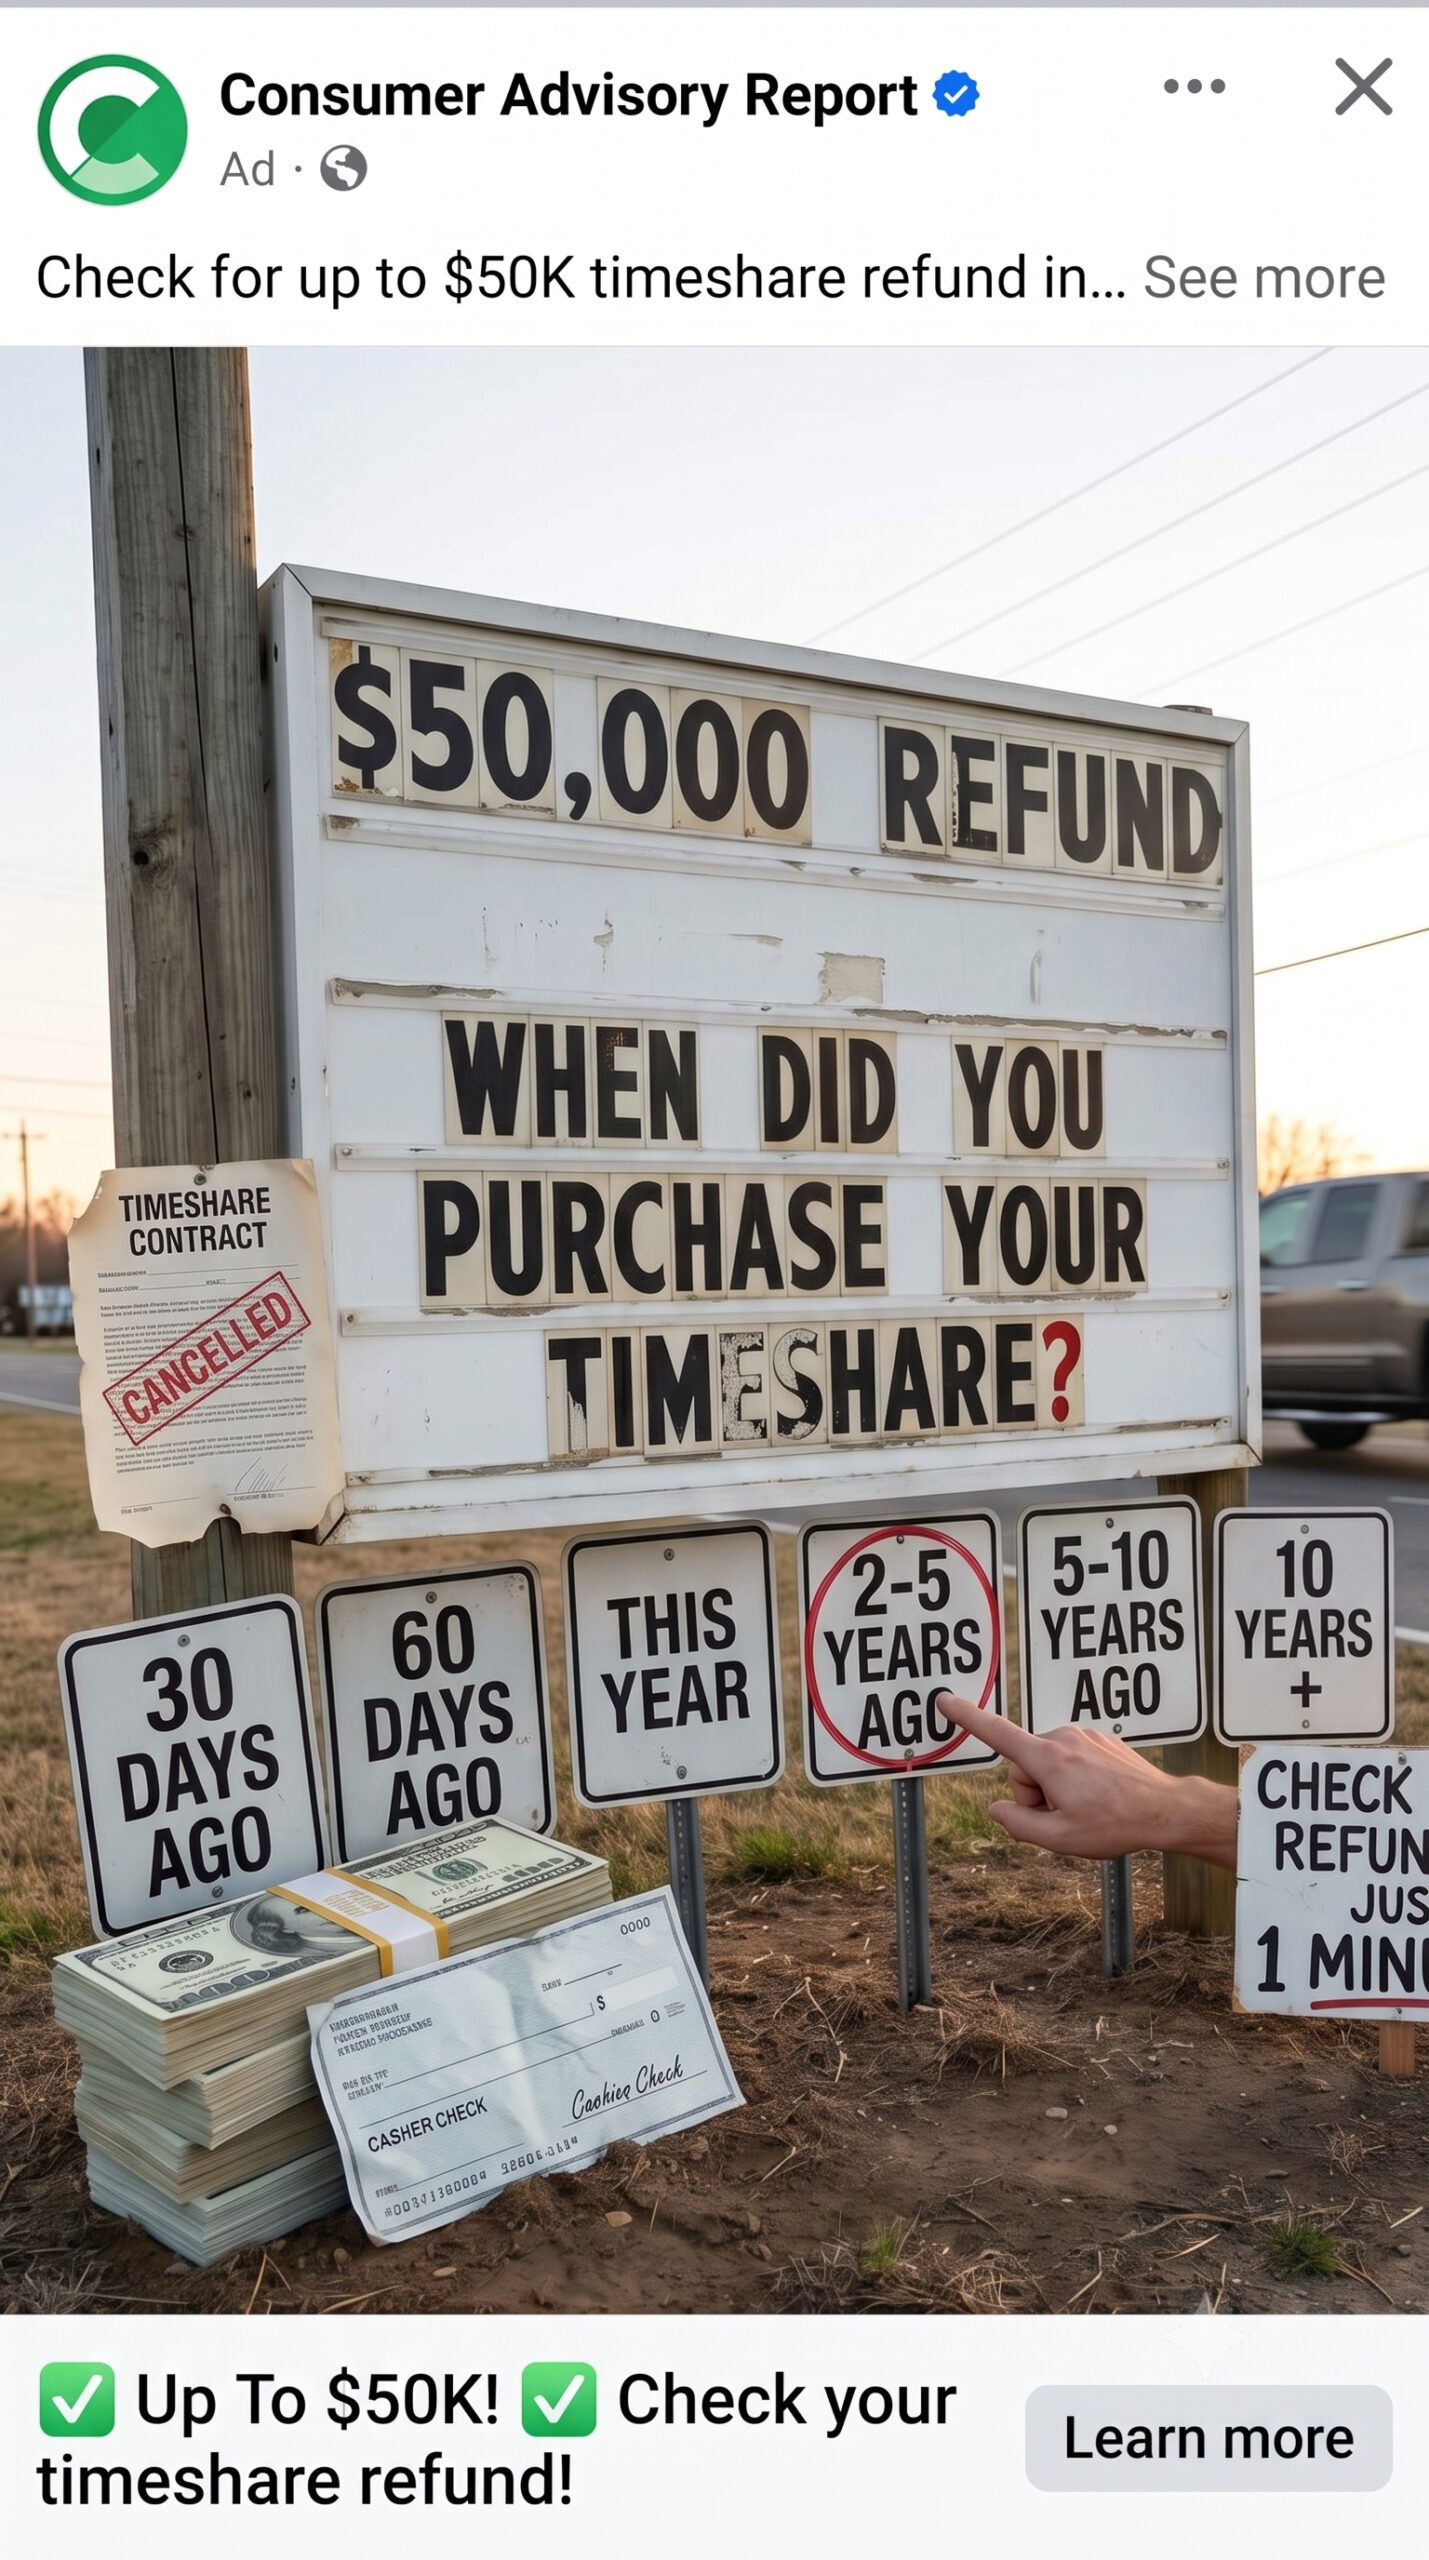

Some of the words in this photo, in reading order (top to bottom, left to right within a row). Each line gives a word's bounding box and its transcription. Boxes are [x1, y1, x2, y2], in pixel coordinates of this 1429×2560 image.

[334, 646, 809, 830] $50,000
[885, 726, 1223, 873] REFUND
[445, 1020, 698, 1140] WHEN
[762, 1035, 896, 1143] DID
[954, 1045, 1104, 1150] YOU
[119, 1187, 271, 1222] TIMESHARE
[129, 1222, 267, 1256] CONTRACT
[423, 1180, 886, 1296] PURCHASE
[945, 1186, 1145, 1285] YOUR
[122, 1292, 292, 1425] CANCELLED
[548, 1321, 1081, 1451] TIMESHARE?
[852, 1548, 950, 1617] 2-5
[1053, 1529, 1169, 1596] 5-10
[1276, 1539, 1333, 1598] 10
[392, 1605, 475, 1680] 60
[607, 1588, 736, 1659] THIS
[824, 1618, 982, 1686] YEARS
[1040, 1598, 1185, 1660] YEARS
[1235, 1608, 1373, 1658] YEARS
[142, 1647, 233, 1732] 30
[363, 1681, 513, 1762] DAYS
[601, 1660, 750, 1733] YEAR
[858, 1687, 957, 1750] AGO
[1070, 1662, 1161, 1722] AGO
[117, 1724, 279, 1822] DAYS
[386, 1757, 502, 1836] AGO
[1257, 1759, 1412, 1815] CHECK
[149, 1806, 272, 1898] AGO
[1350, 1883, 1429, 1925] JUS
[1257, 1925, 1286, 1992] 1
[1309, 1933, 1429, 1993] MIN
[368, 2116, 434, 2152] CASHER
[435, 2096, 488, 2128] CHECK
